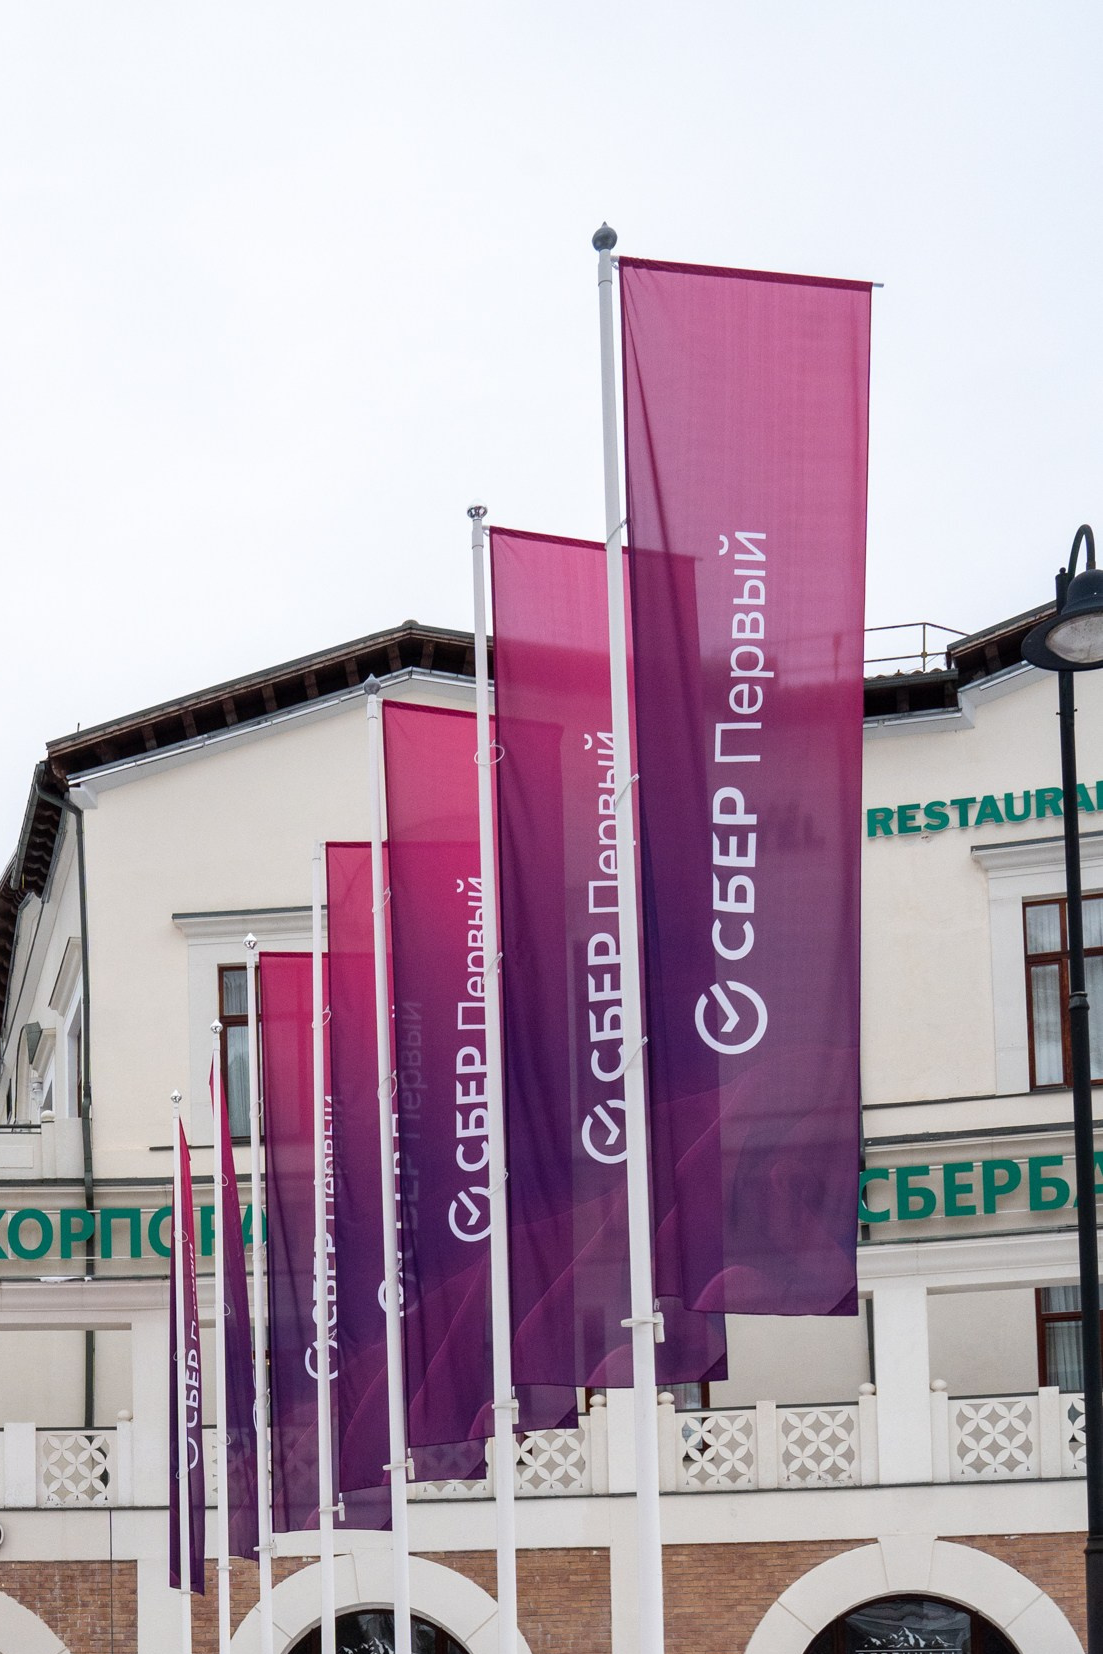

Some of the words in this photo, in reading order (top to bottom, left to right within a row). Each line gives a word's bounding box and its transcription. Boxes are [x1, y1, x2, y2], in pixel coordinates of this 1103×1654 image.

[713, 530, 775, 763] Первый
[584, 731, 619, 914] Первый
[711, 786, 757, 961] СБЕР
[588, 931, 624, 1083] СБЕР
[456, 1045, 490, 1173] СБЕР
